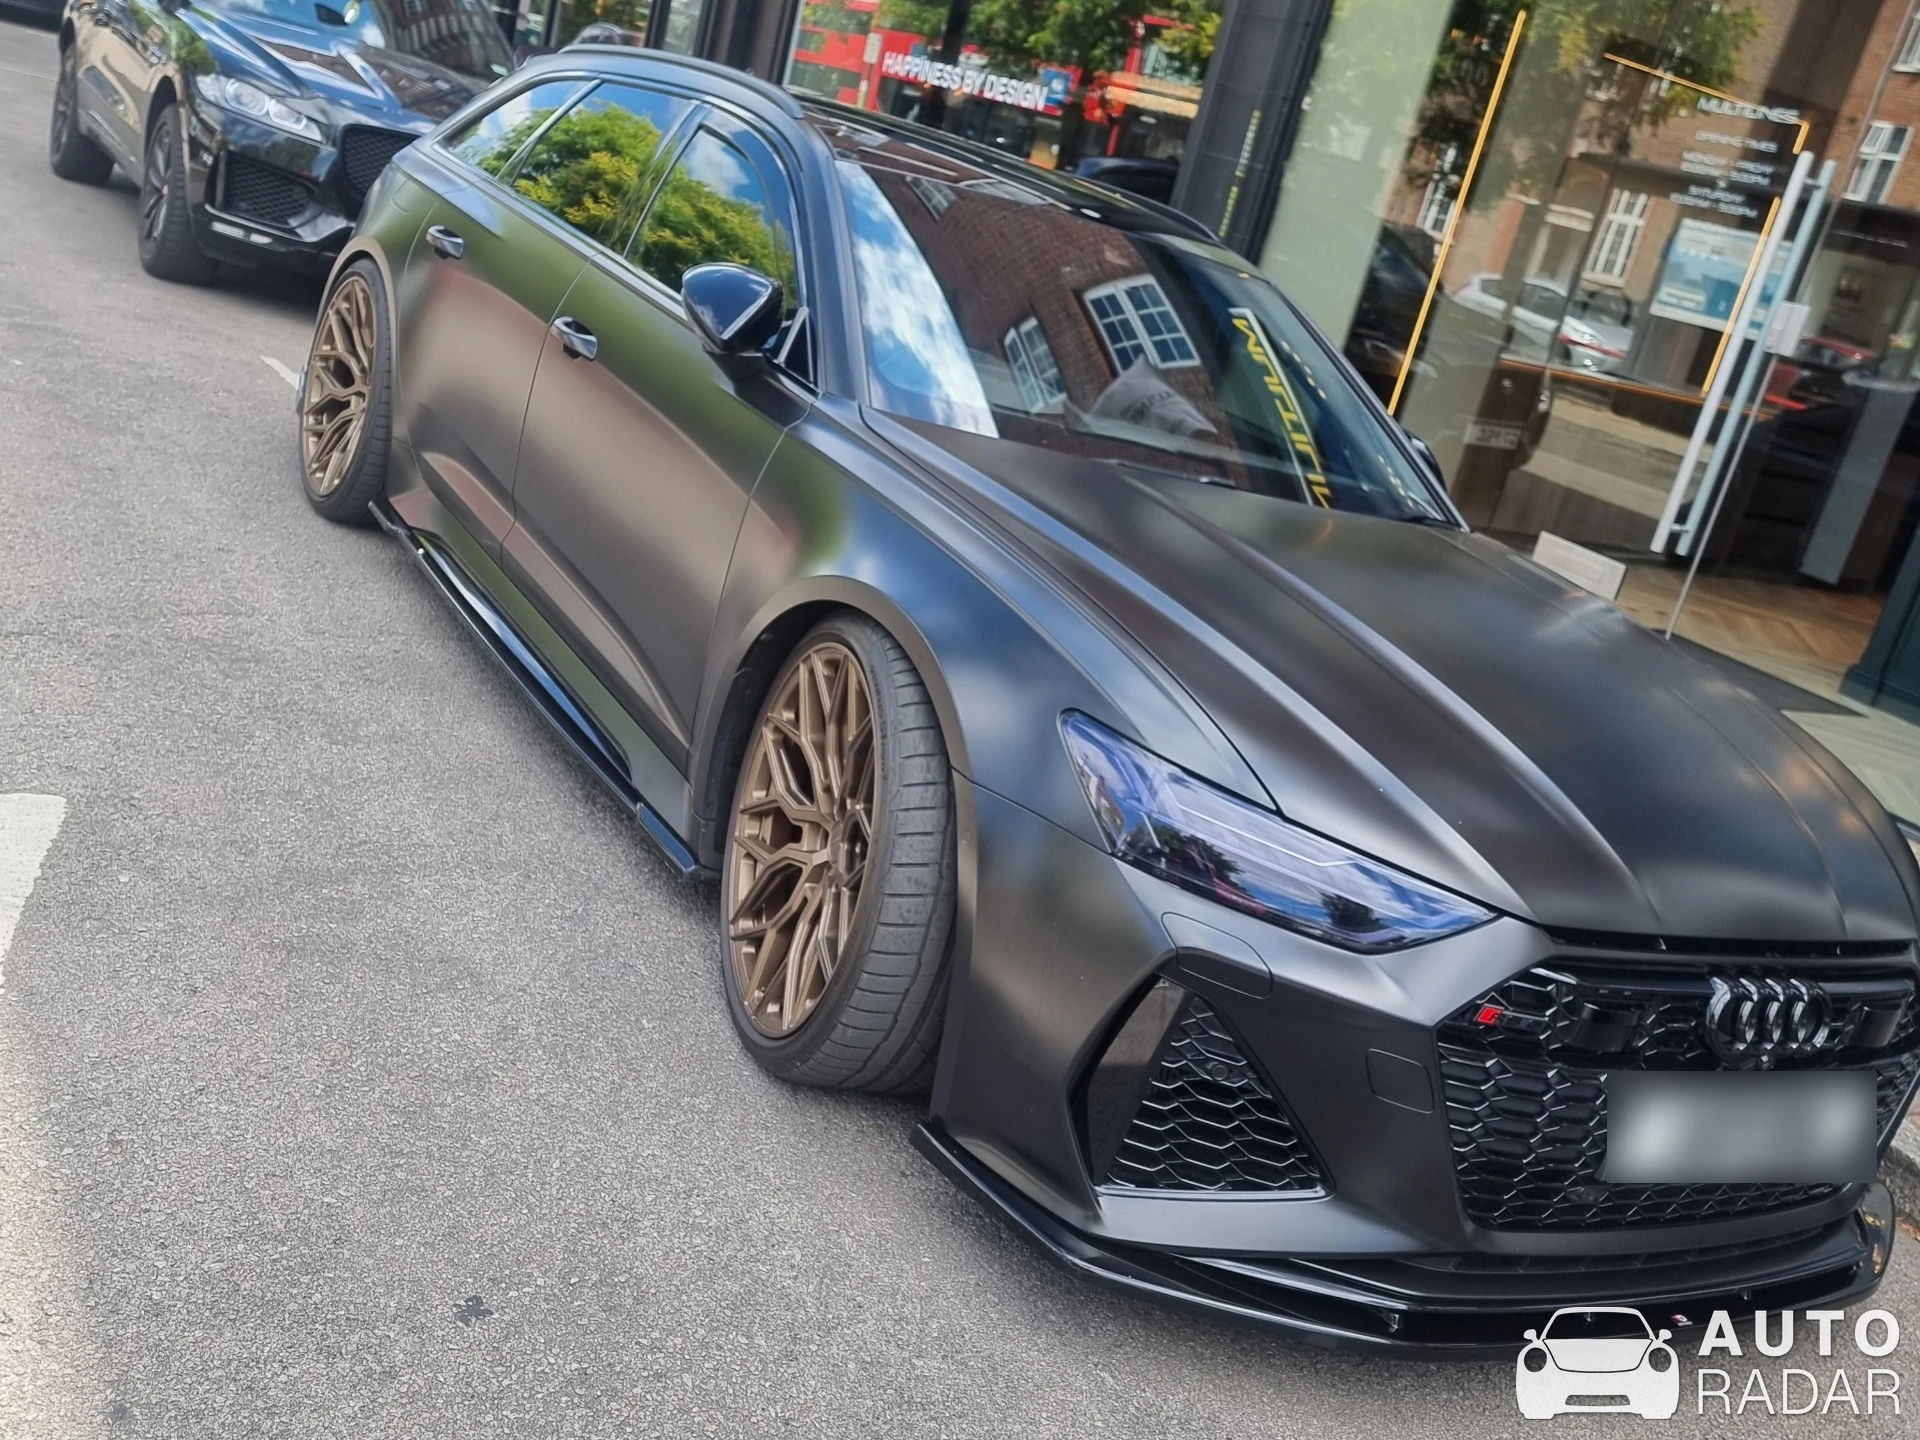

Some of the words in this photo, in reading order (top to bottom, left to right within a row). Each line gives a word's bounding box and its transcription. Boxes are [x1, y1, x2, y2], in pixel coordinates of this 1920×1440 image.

[881, 51, 964, 91] HAPPINESS
[962, 69, 987, 96] BY
[984, 74, 1049, 111] DESIGN
